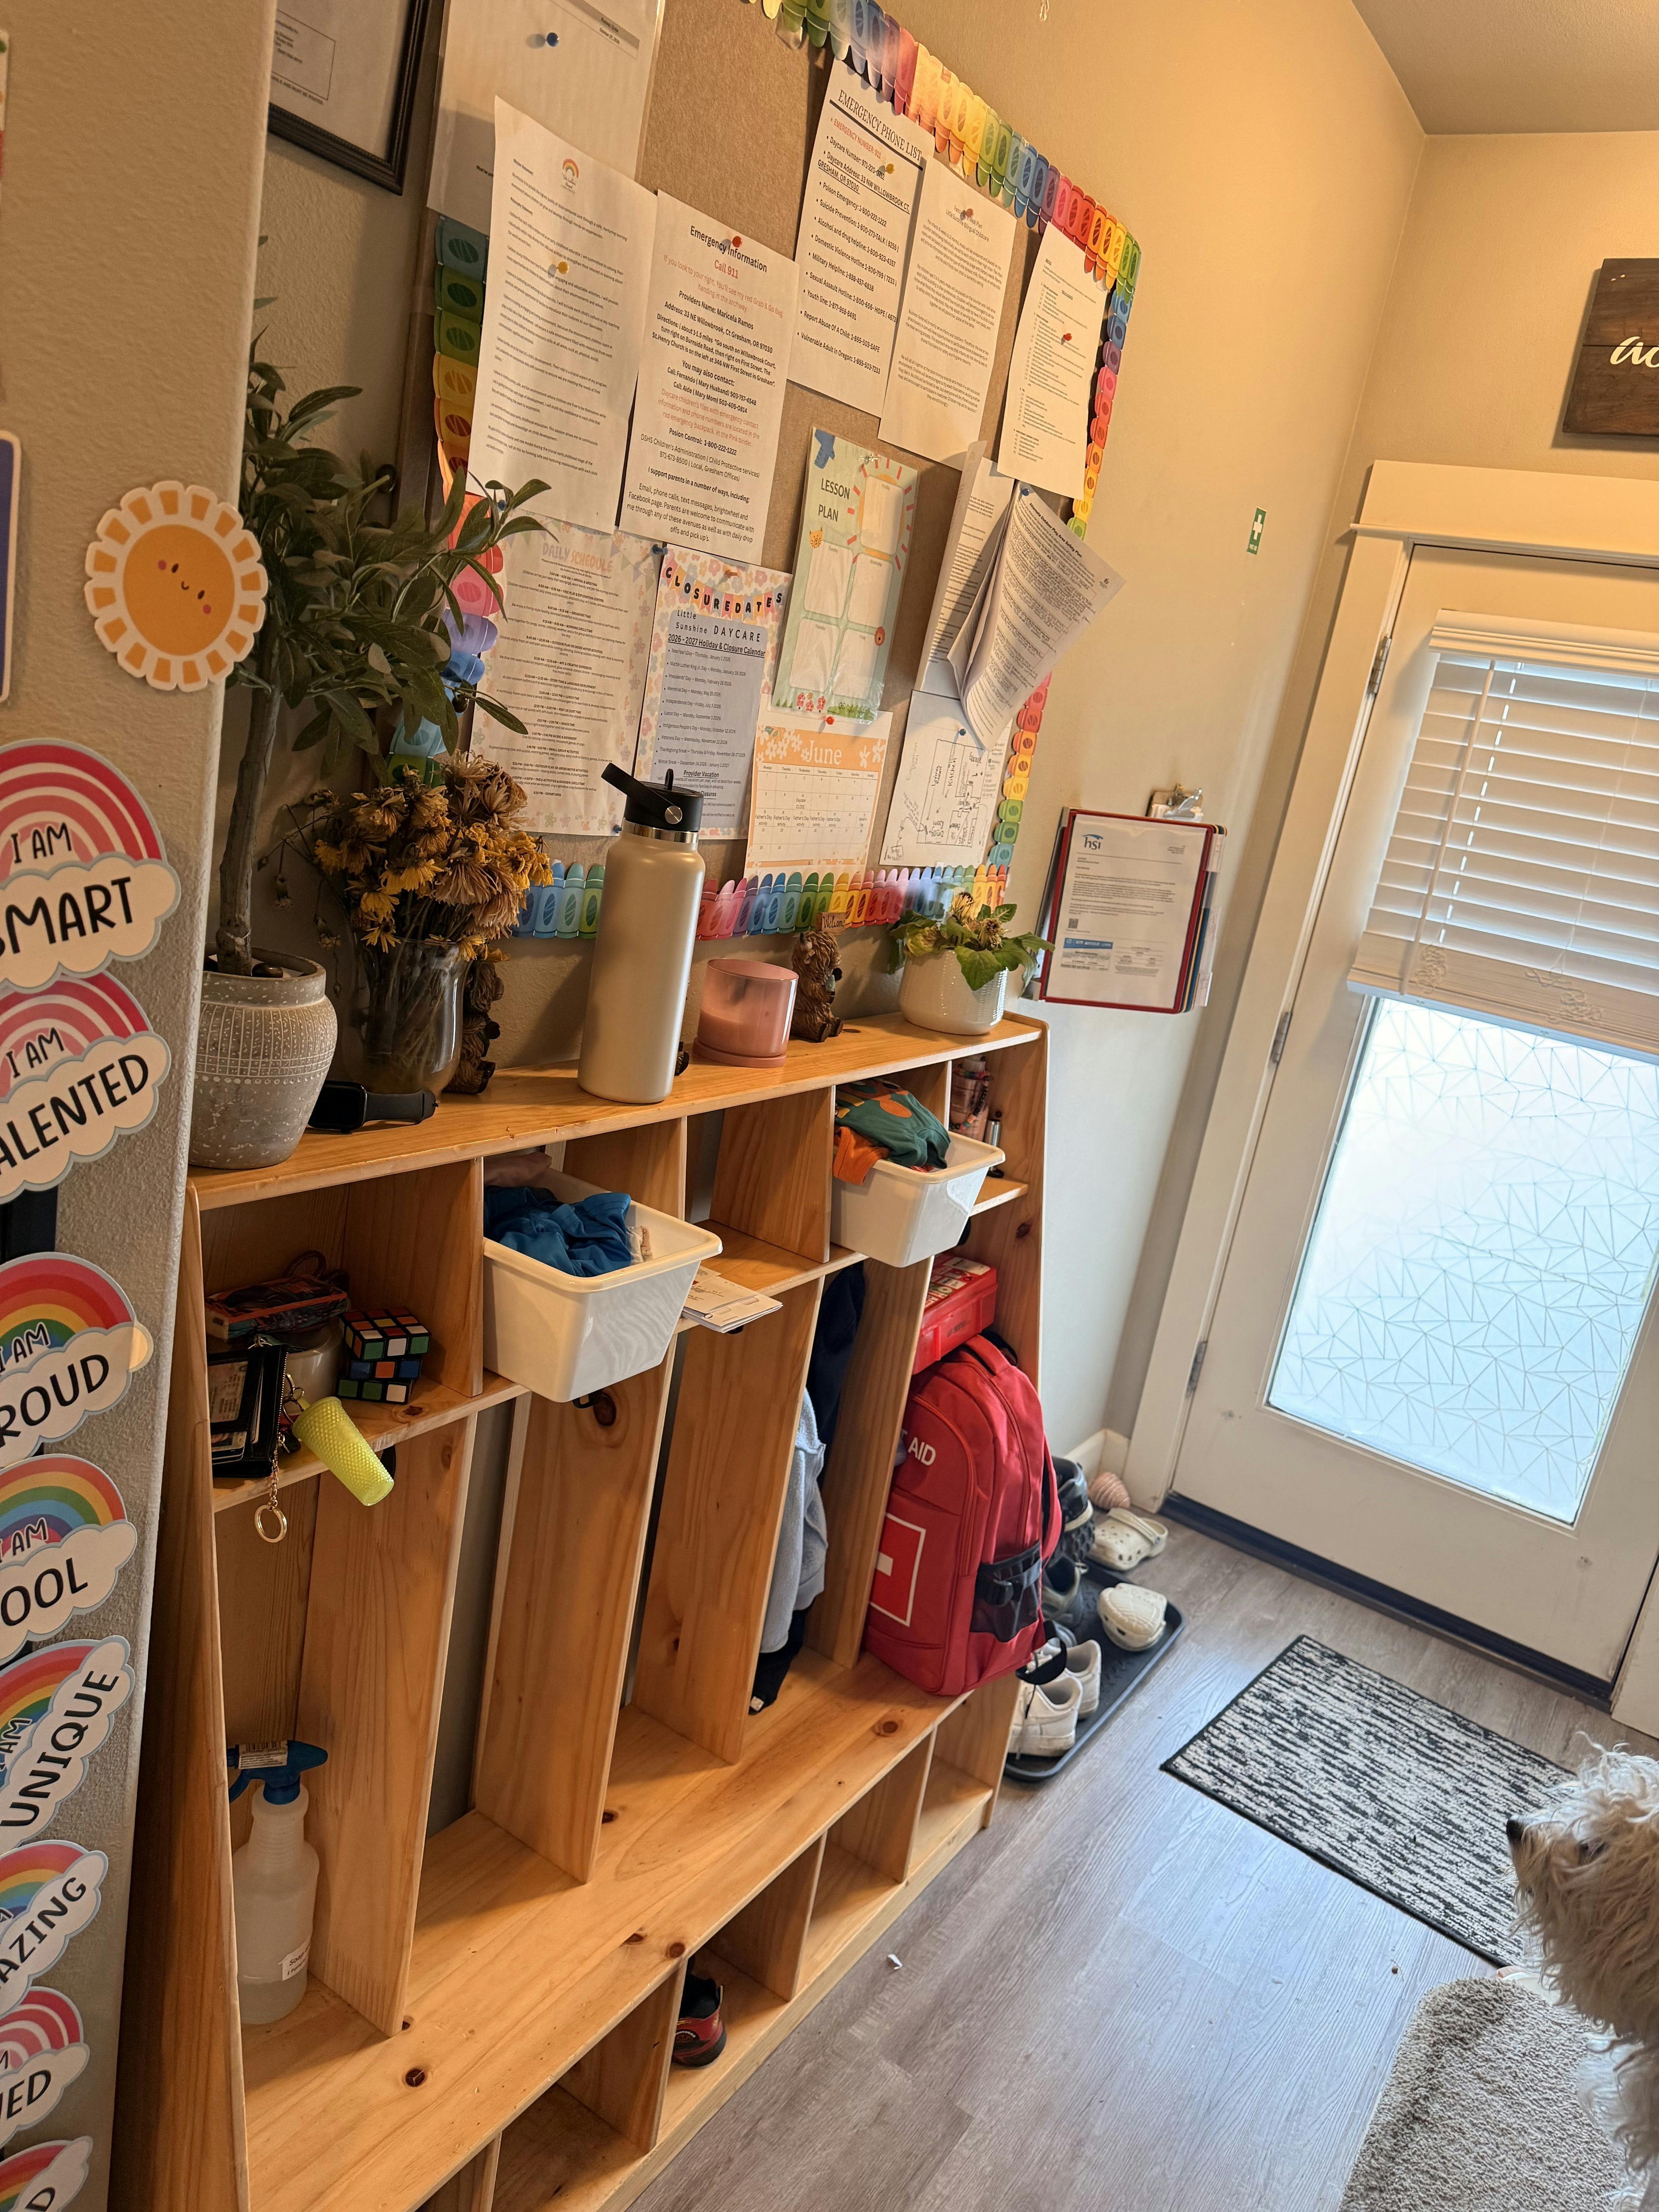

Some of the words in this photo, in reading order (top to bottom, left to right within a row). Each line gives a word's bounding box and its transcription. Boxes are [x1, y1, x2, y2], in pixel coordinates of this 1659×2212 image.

[834, 118, 857, 141] EMERGENCY
[857, 136, 874, 154] NUMBER:
[838, 89, 882, 130] EMERGENCY
[881, 124, 905, 149] PHONE
[905, 142, 922, 161] LIST
[830, 136, 845, 153] Daycare
[845, 148, 861, 164] Number:
[827, 151, 843, 168] Daycare
[843, 163, 860, 180] Address:
[860, 175, 866, 184] 33
[866, 179, 873, 188] NW
[874, 183, 903, 208] WILLOWBROOK
[840, 174, 846, 183] OR
[846, 179, 859, 192] 97030
[823, 182, 836, 196] Poison
[836, 191, 859, 210] Emergency:
[859, 205, 887, 227] 1-800-222-1222
[690, 225, 726, 254] Emergency
[728, 245, 767, 273] Information
[714, 259, 726, 273] Call
[727, 266, 738, 279] 911
[812, 252, 828, 268] Military
[828, 261, 845, 276] Helpline:
[846, 271, 874, 292] 1-888-457-4838
[679, 290, 701, 306] Providers
[701, 301, 716, 314] Name:
[717, 308, 737, 323] Maricela
[738, 317, 753, 330] Ramos
[807, 289, 819, 301] Youth
[819, 295, 828, 306] line:
[829, 301, 856, 320] 1-877-968-8491
[665, 301, 684, 315] Address:
[690, 313, 696, 321] NE
[697, 316, 725, 335] Willowbrook,
[732, 331, 752, 346] Gresham,
[759, 343, 773, 353] 97030
[804, 311, 818, 323] Report
[818, 318, 831, 329] Abuse
[840, 328, 850, 338] Child:
[851, 334, 880, 352] 1-855-503-SAFE
[801, 332, 822, 347] Vulnerable
[823, 343, 833, 352] Adult
[838, 350, 853, 362] Oregon:
[853, 357, 880, 374] 1-855-503-7233
[677, 371, 695, 383] Fernando
[698, 380, 709, 390] Mary
[709, 384, 730, 397] Husband)
[730, 391, 756, 405] 503-757-4548
[682, 360, 691, 369] You
[692, 366, 702, 375] may
[703, 369, 713, 378] also
[714, 374, 735, 386] contact:
[685, 433, 702, 444] Control:
[704, 440, 737, 455] 1-800-222-1222
[639, 483, 653, 494] Email,
[653, 488, 668, 498] phone
[668, 493, 680, 502] calls,
[690, 500, 713, 512] messages,
[651, 469, 667, 478] support
[668, 474, 685, 483] parents
[694, 482, 711, 491] number
[718, 489, 729, 498] ways,
[821, 478, 850, 500] LESSON
[818, 504, 838, 522] PLAN
[1041, 516, 1052, 529] Outdoor
[542, 543, 570, 561] DAILY
[571, 550, 613, 572] SCHEDULE
[676, 622, 707, 634] Sunshine
[677, 610, 696, 619] Little
[668, 634, 681, 642] 2026
[685, 637, 698, 645] 2027
[699, 639, 718, 649] Holiday
[723, 643, 743, 653] Closure
[744, 647, 766, 658] Calendar
[714, 625, 761, 642] DAYCARE
[806, 740, 842, 765] June
[948, 758, 957, 786] Kitchen
[11, 833, 22, 864] I
[32, 822, 72, 859] AM
[1084, 836, 1101, 850] hsi
[0, 877, 132, 957] MART
[6, 1051, 21, 1079] I
[26, 1027, 64, 1068] AM
[0, 1054, 148, 1173] ALENTED
[13, 1323, 49, 1363] AM
[0, 1354, 109, 1448] ROUD
[908, 1437, 936, 1466] AID
[13, 1518, 47, 1556] AM
[1, 1558, 88, 1626] OOL
[0, 1719, 31, 1753] AM
[0, 1671, 119, 1827] UNIQUE
[0, 1877, 86, 1984] AZING
